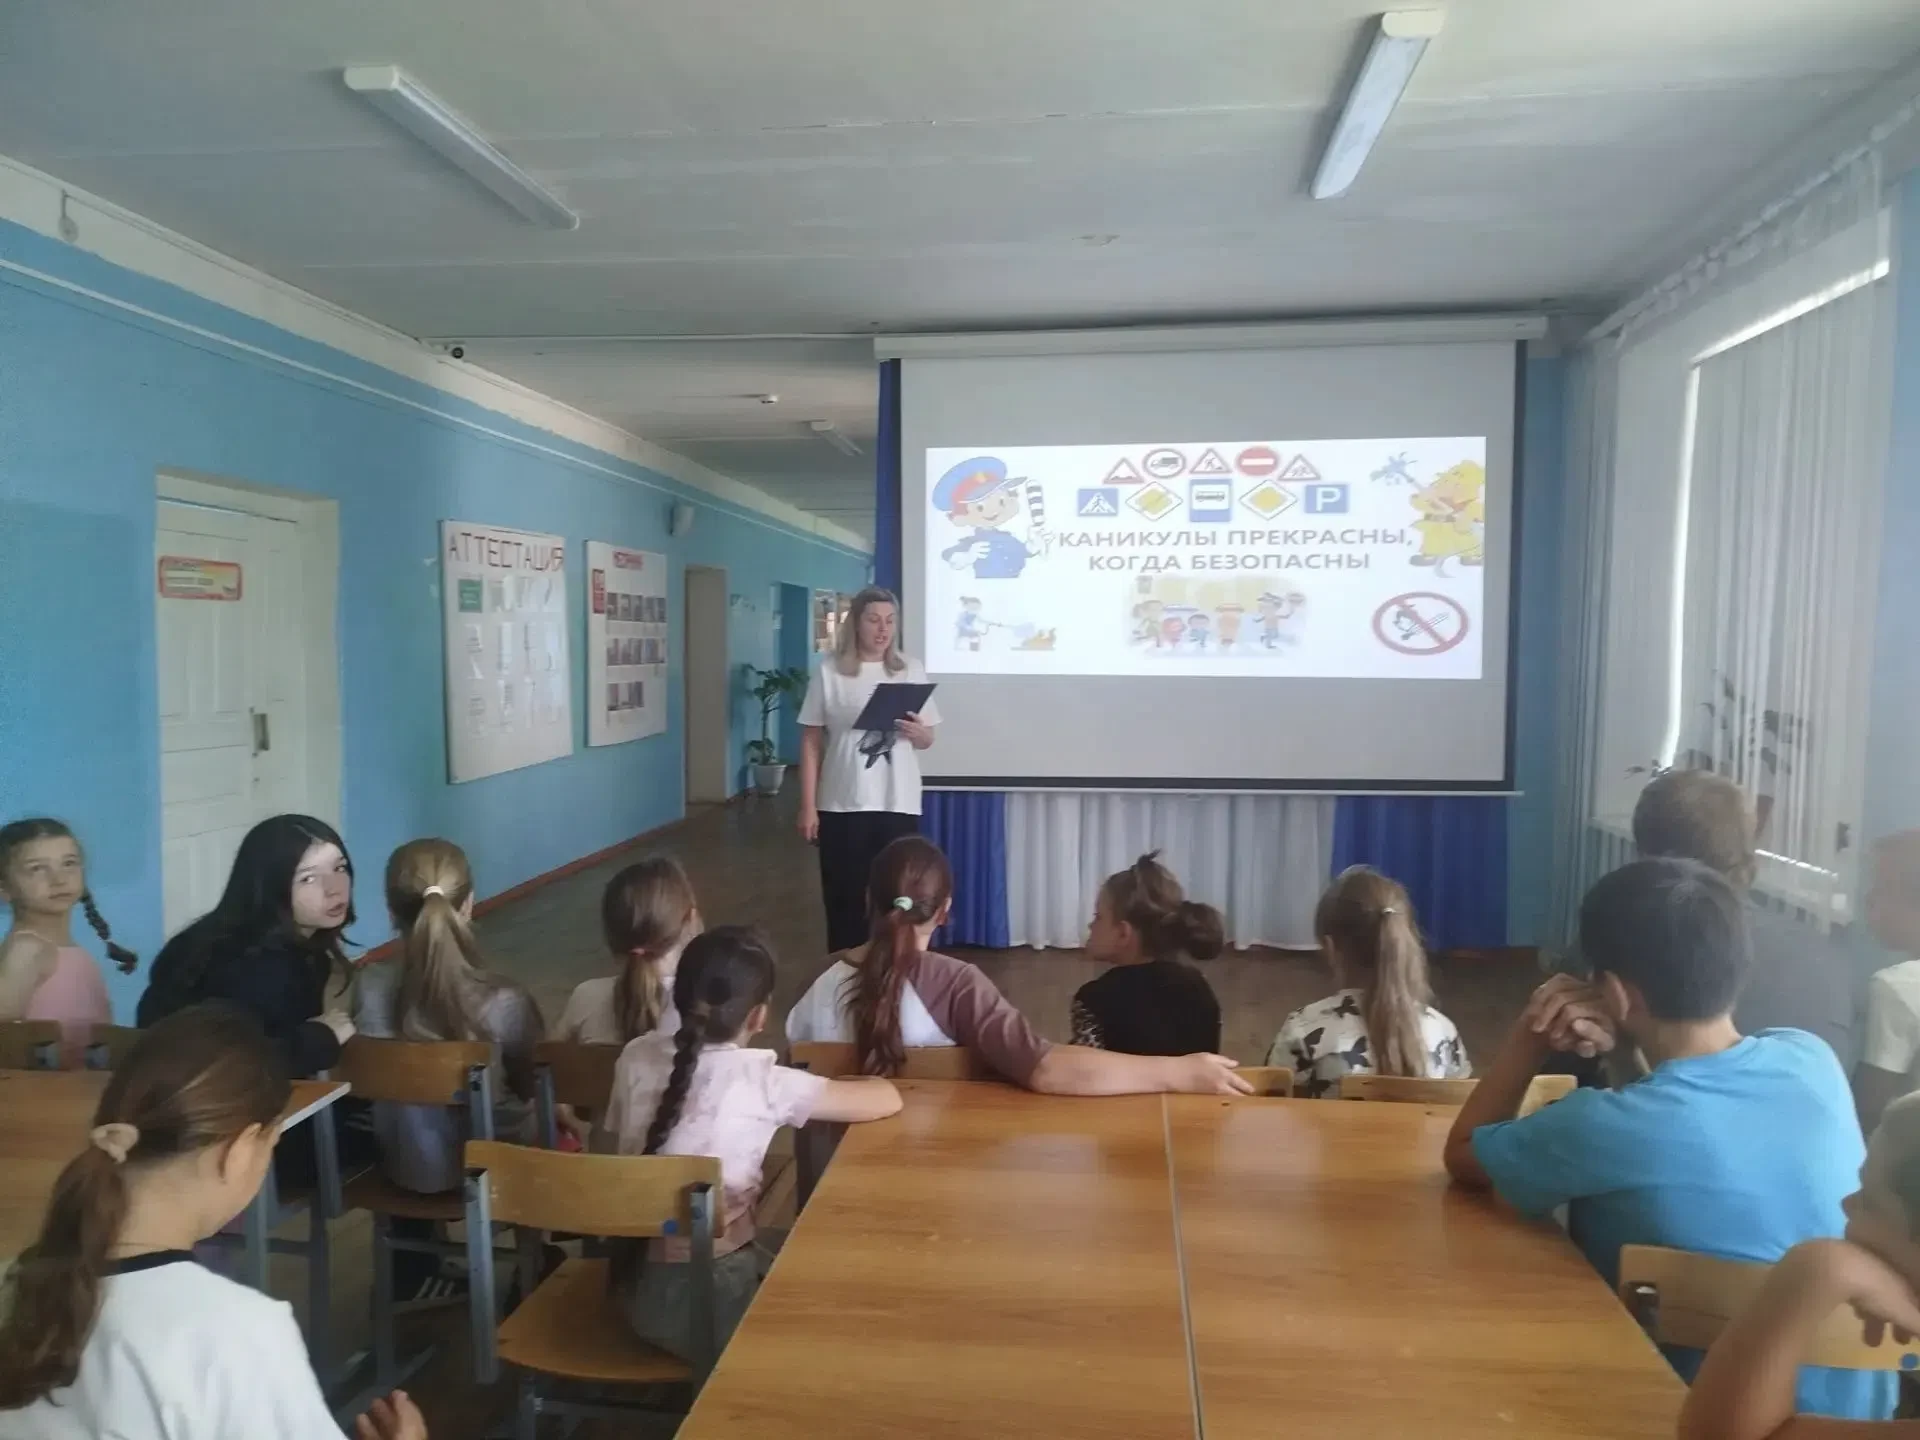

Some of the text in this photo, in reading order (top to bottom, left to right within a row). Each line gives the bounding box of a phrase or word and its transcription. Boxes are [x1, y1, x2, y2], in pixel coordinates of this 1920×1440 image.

[1059, 529, 1413, 547] КАНИКУЛЫ ПРЕКРАСНЫ,
[1089, 553, 1370, 573] КОГДА БЕЗОПАСНЫ
